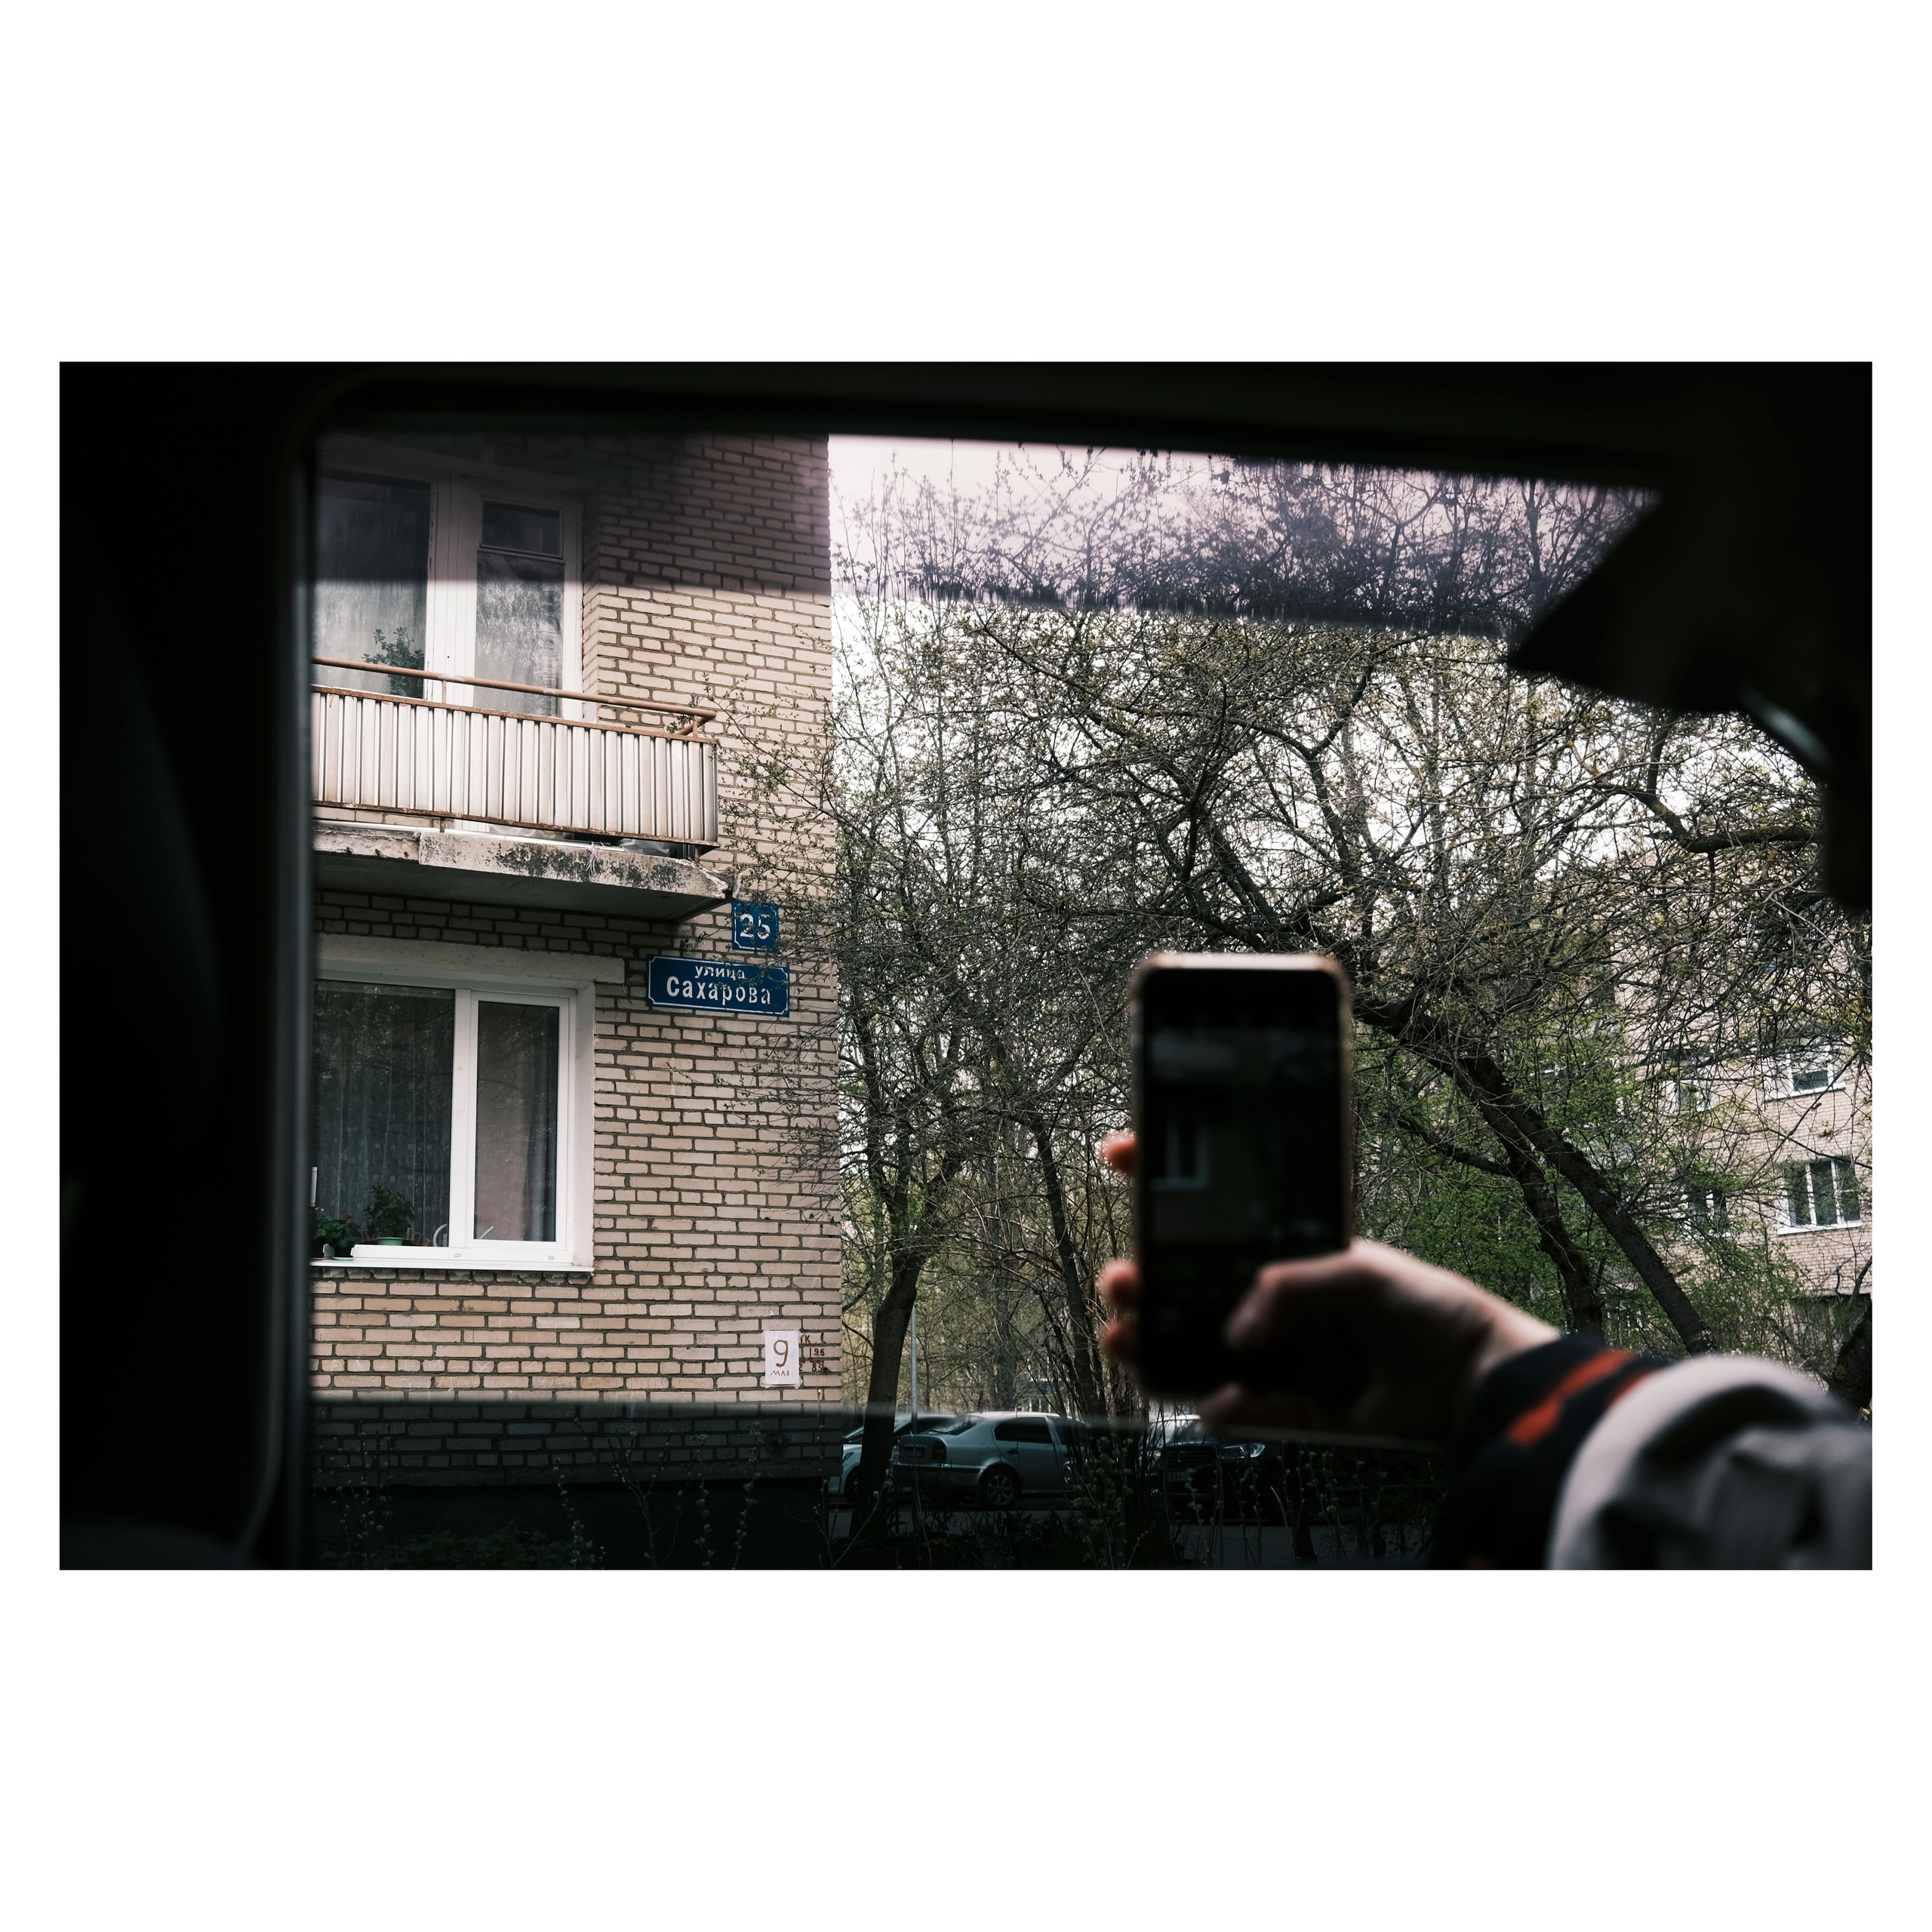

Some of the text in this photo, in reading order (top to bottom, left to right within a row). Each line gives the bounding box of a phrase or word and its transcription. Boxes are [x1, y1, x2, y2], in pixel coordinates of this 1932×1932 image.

[740, 913, 771, 940] 25
[694, 965, 746, 981] улица
[666, 976, 771, 1006] Сахарова
[773, 1340, 789, 1368] 9
